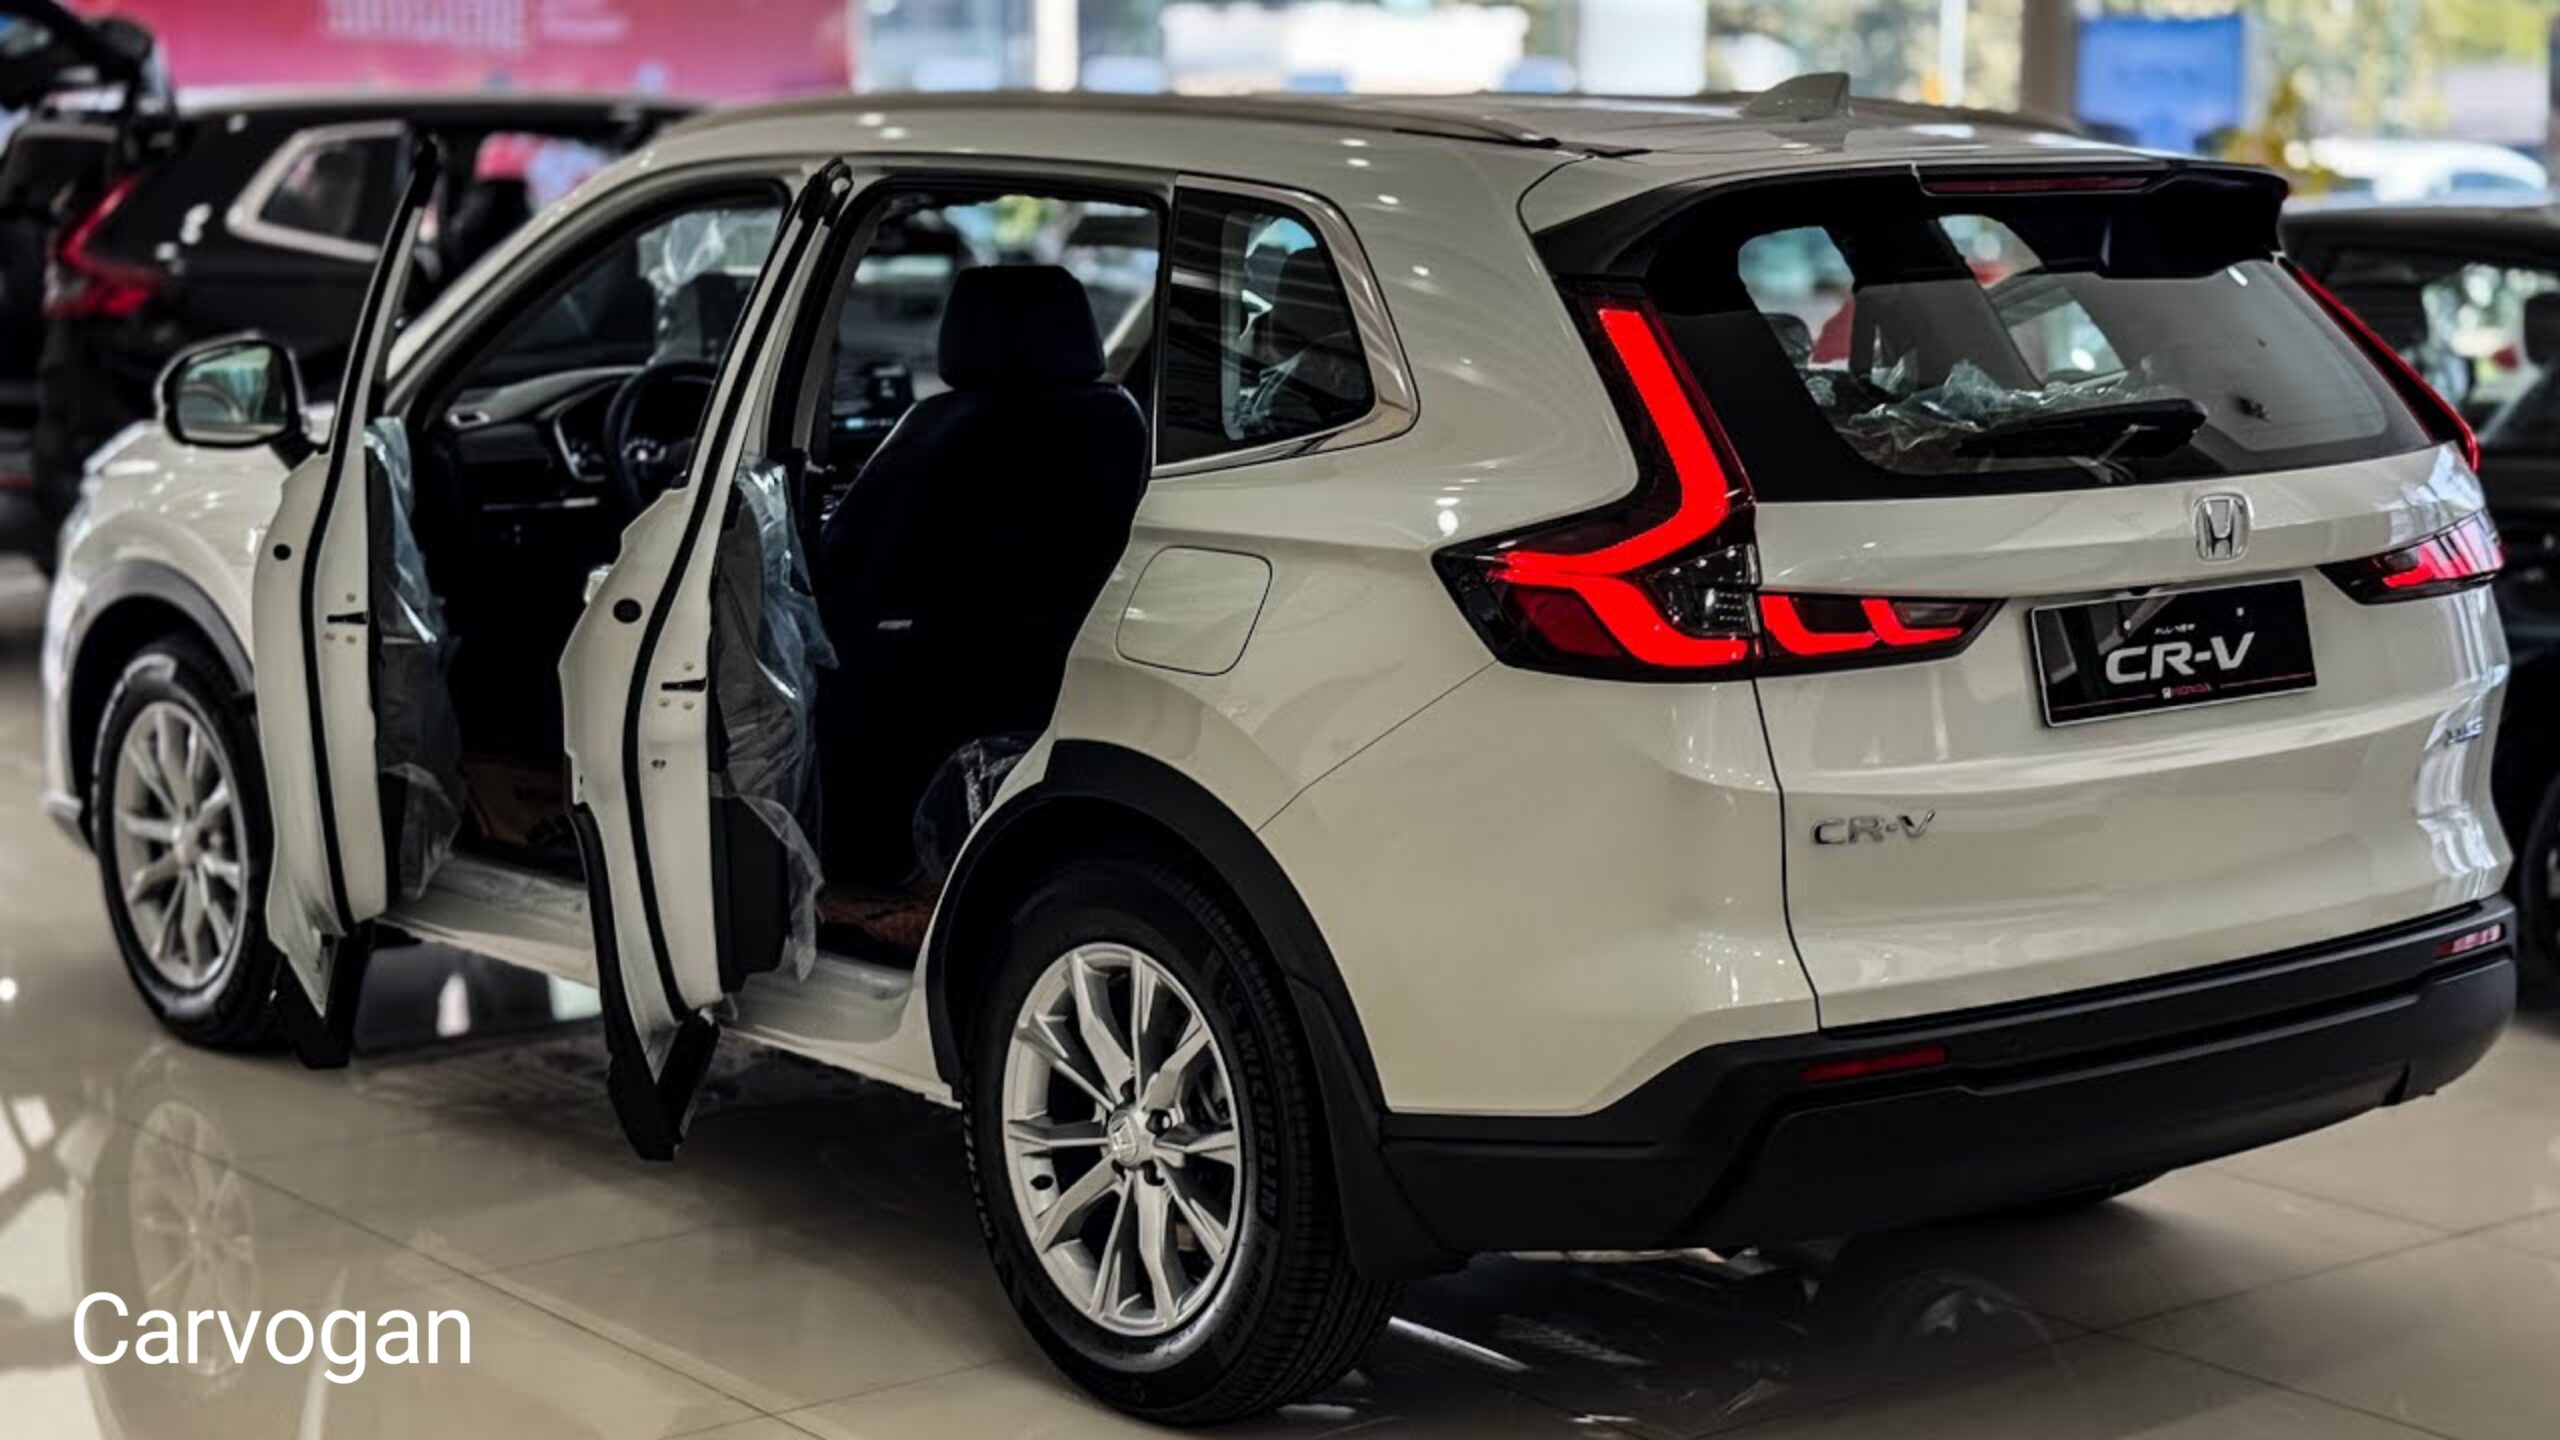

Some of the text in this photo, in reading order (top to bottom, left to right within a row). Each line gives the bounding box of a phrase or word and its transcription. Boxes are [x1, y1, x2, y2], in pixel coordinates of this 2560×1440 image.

[2105, 631, 2255, 684] CR-V
[1811, 810, 1935, 846] CR-V
[1235, 1029, 1279, 1219] MICHELIN
